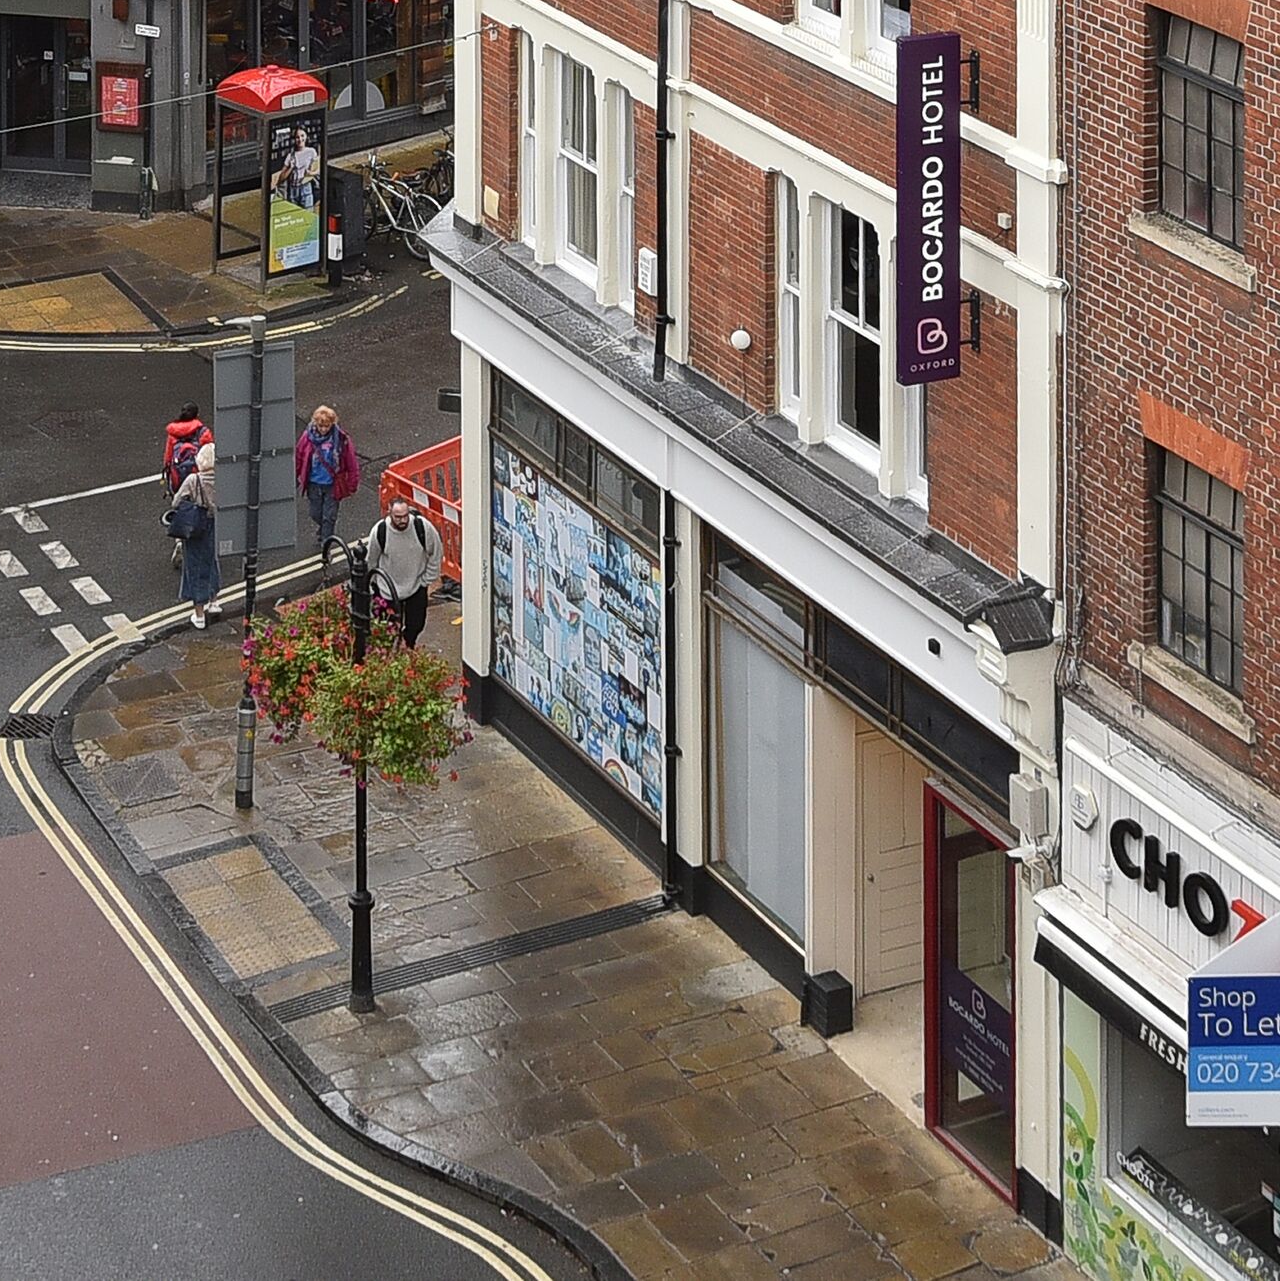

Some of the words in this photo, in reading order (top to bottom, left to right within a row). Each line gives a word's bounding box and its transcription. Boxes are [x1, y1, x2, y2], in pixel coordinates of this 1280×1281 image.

[921, 55, 944, 145] HOTEL
[922, 156, 944, 302] BOCARDO
[910, 358, 955, 373] OXFORD
[1198, 987, 1256, 1011] Shop
[948, 995, 985, 1035] BOCARDO
[986, 1029, 1010, 1058] HOTEL
[1197, 1013, 1233, 1037] To
[1197, 1062, 1239, 1083] 020
